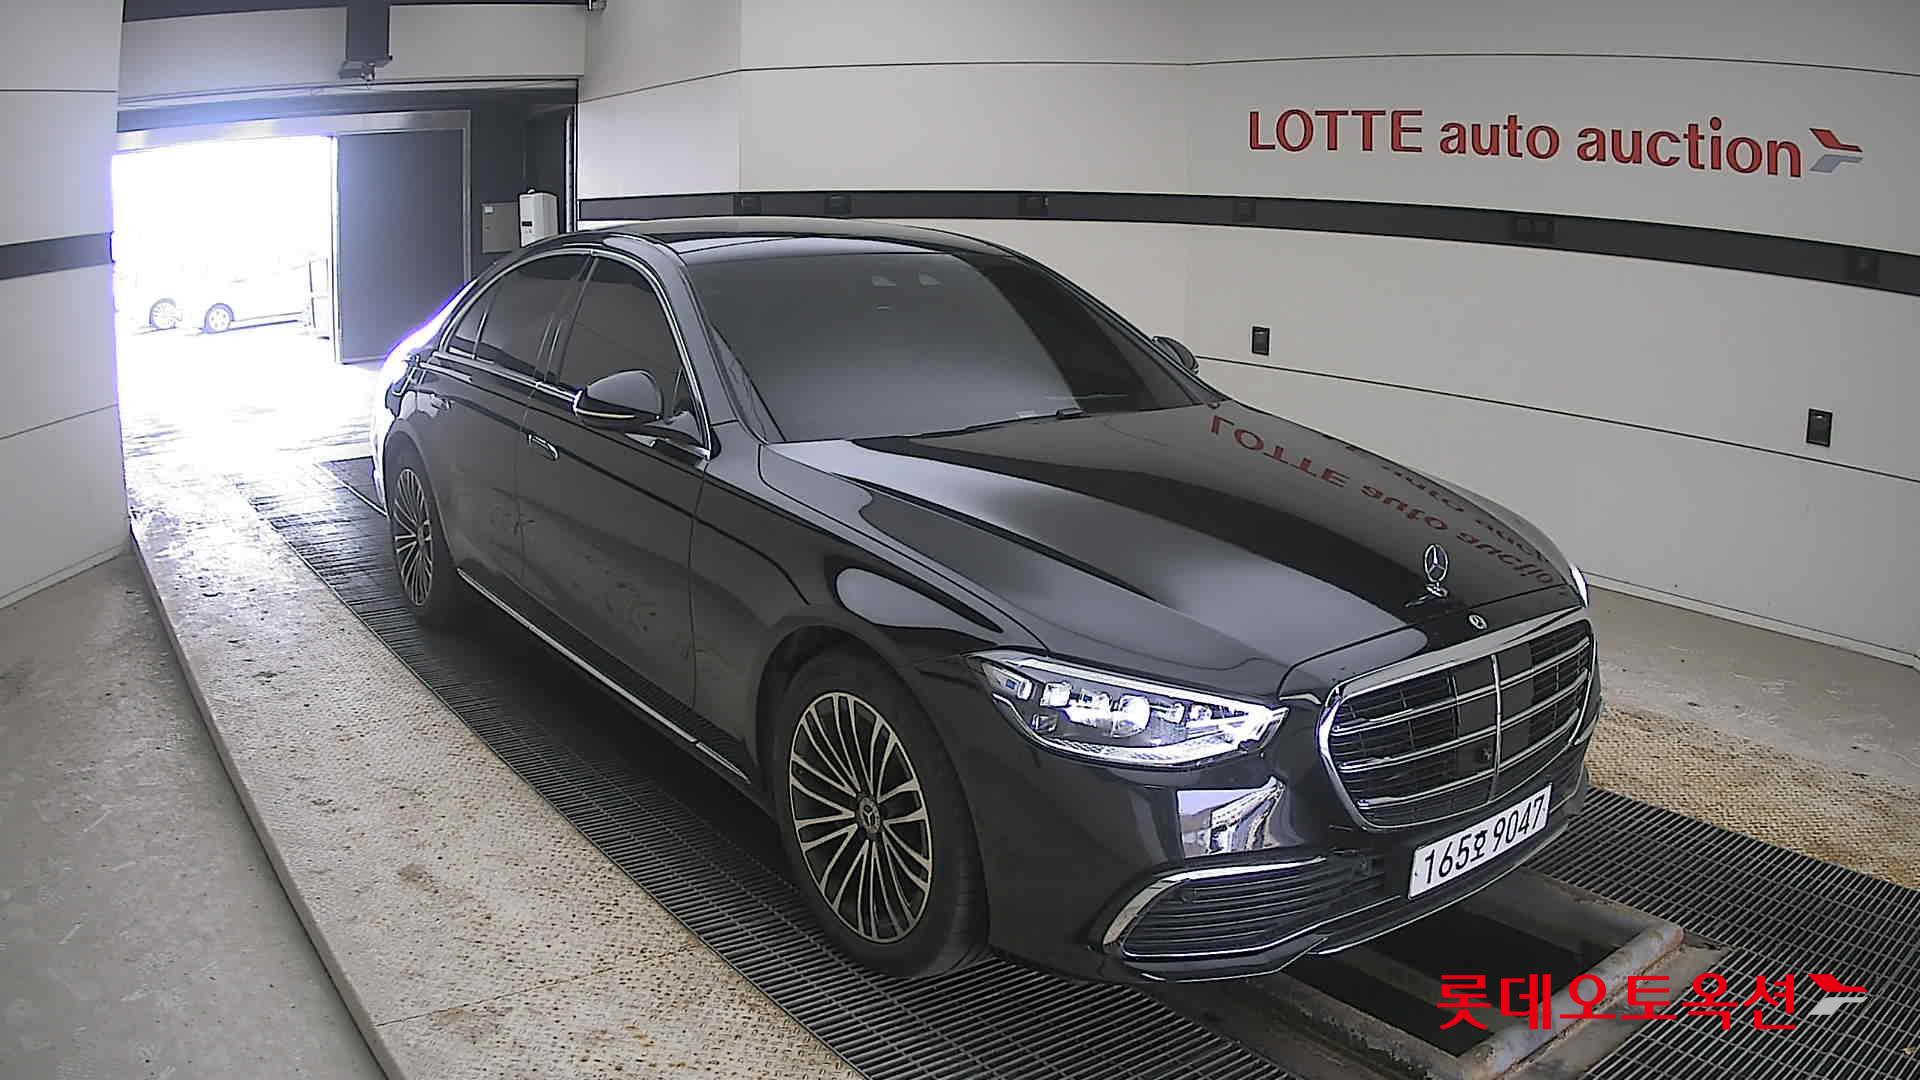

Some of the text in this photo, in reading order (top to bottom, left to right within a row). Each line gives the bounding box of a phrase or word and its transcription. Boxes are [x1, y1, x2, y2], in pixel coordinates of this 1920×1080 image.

[1249, 109, 1802, 178] LOTTE auto auction
[1493, 796, 1545, 852] 9047
